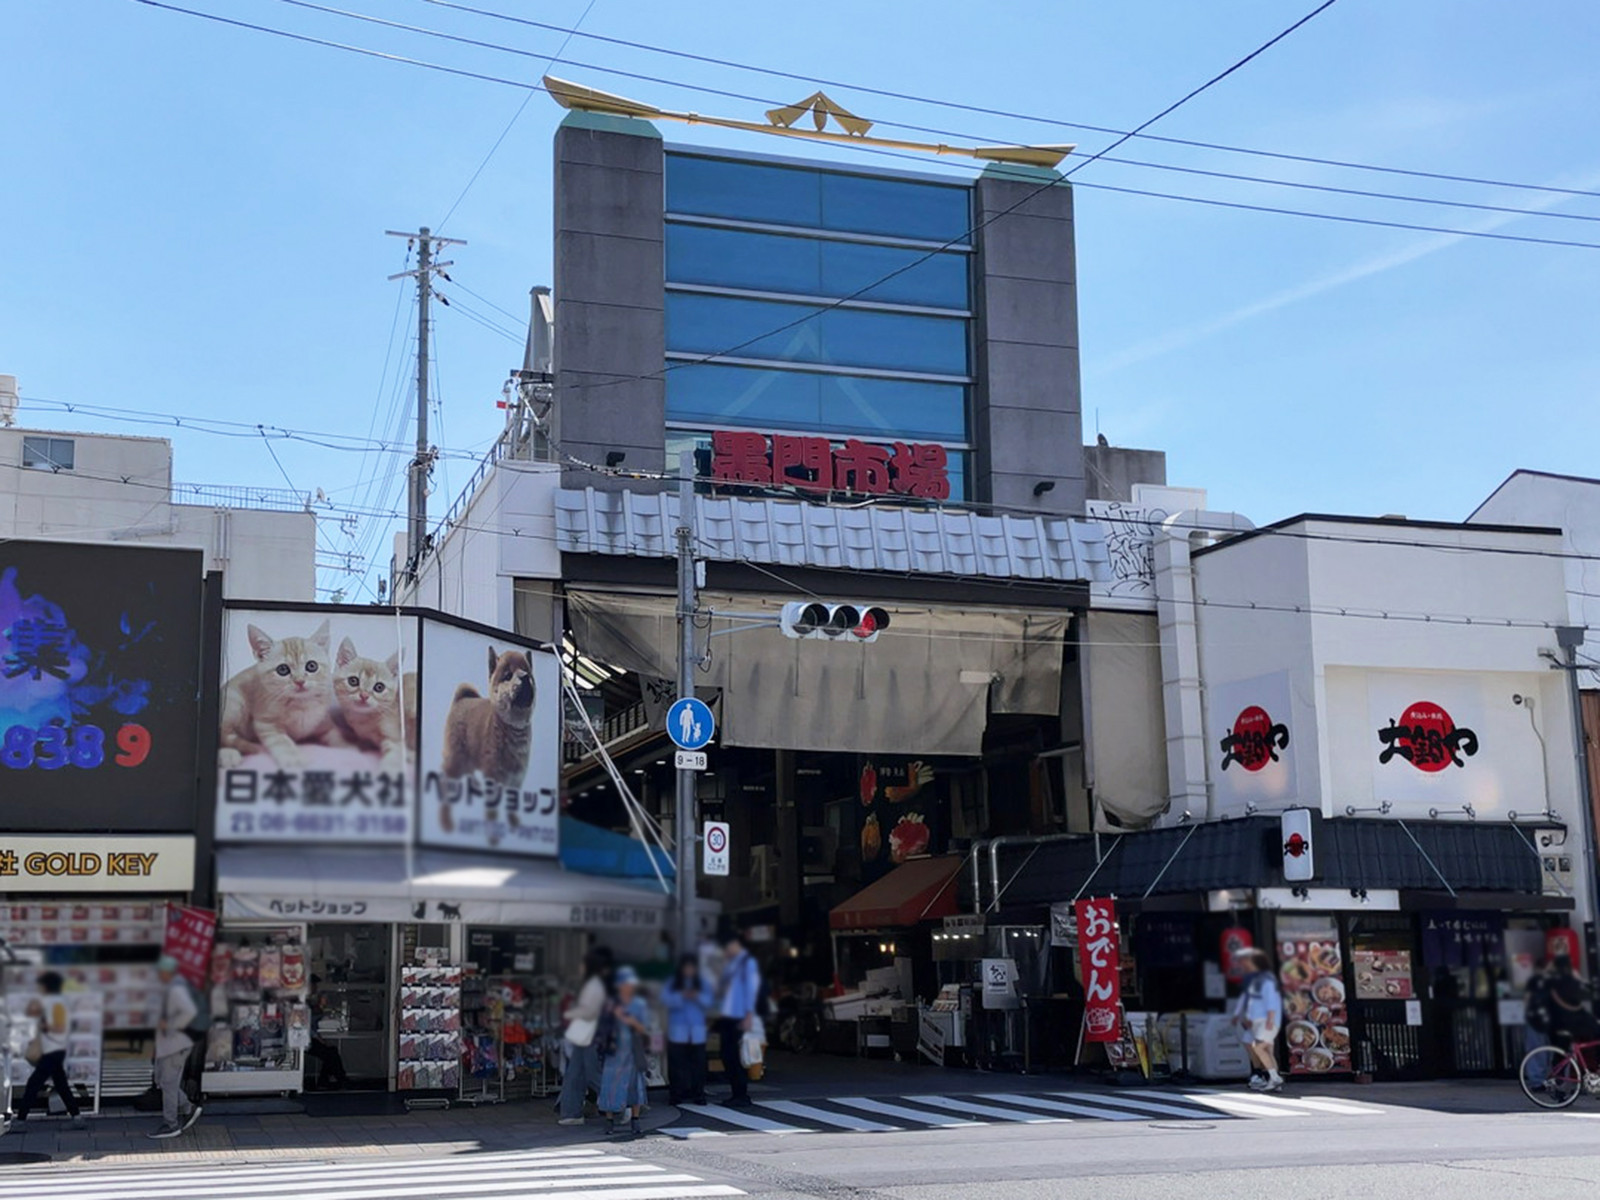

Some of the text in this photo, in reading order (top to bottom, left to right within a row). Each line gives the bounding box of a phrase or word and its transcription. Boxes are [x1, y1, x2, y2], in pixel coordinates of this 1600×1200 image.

[712, 430, 950, 499] 黒門市場
[224, 767, 407, 808] 日本愛犬社
[712, 833, 722, 846] 30
[24, 852, 102, 876] GOLD
[107, 852, 159, 876] KEY
[269, 899, 368, 915] ペットショップ
[1084, 904, 1116, 1002] おでん
